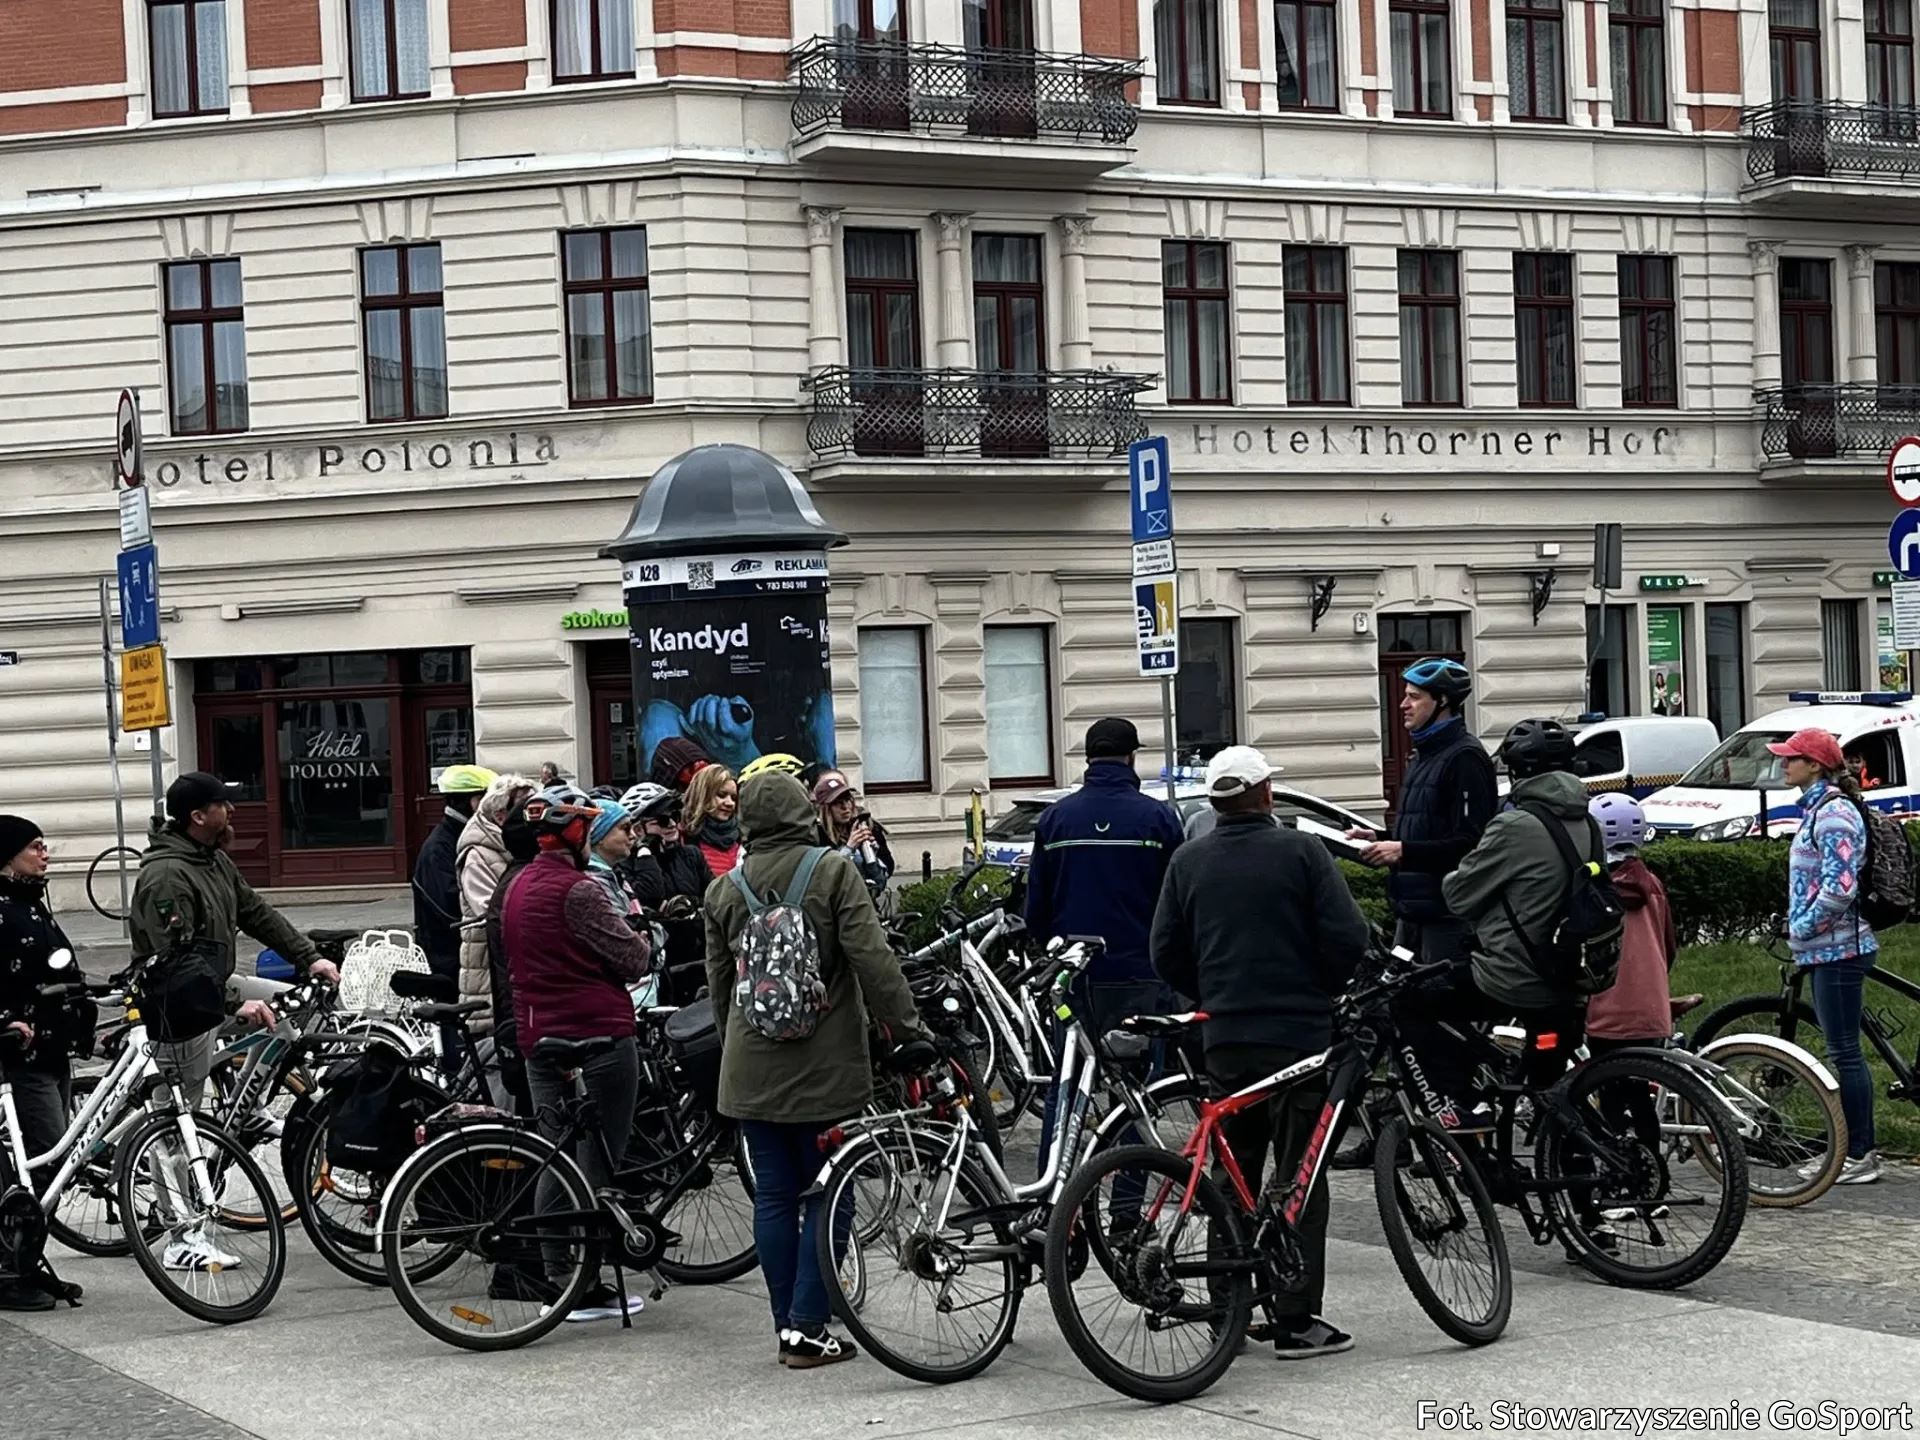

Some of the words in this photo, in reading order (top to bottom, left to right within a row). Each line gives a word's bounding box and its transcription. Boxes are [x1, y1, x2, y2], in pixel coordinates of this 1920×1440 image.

[1192, 424, 1330, 455] Hotel
[1352, 425, 1562, 455] Thorner
[1588, 426, 1670, 455] Hof
[318, 432, 560, 477] Polonia
[1138, 448, 1160, 512] P
[640, 564, 660, 582] A28
[1644, 578, 1684, 586] VELO
[649, 622, 749, 655] Kandyd
[306, 730, 362, 758] Hotel
[289, 762, 380, 779] POLONIA
